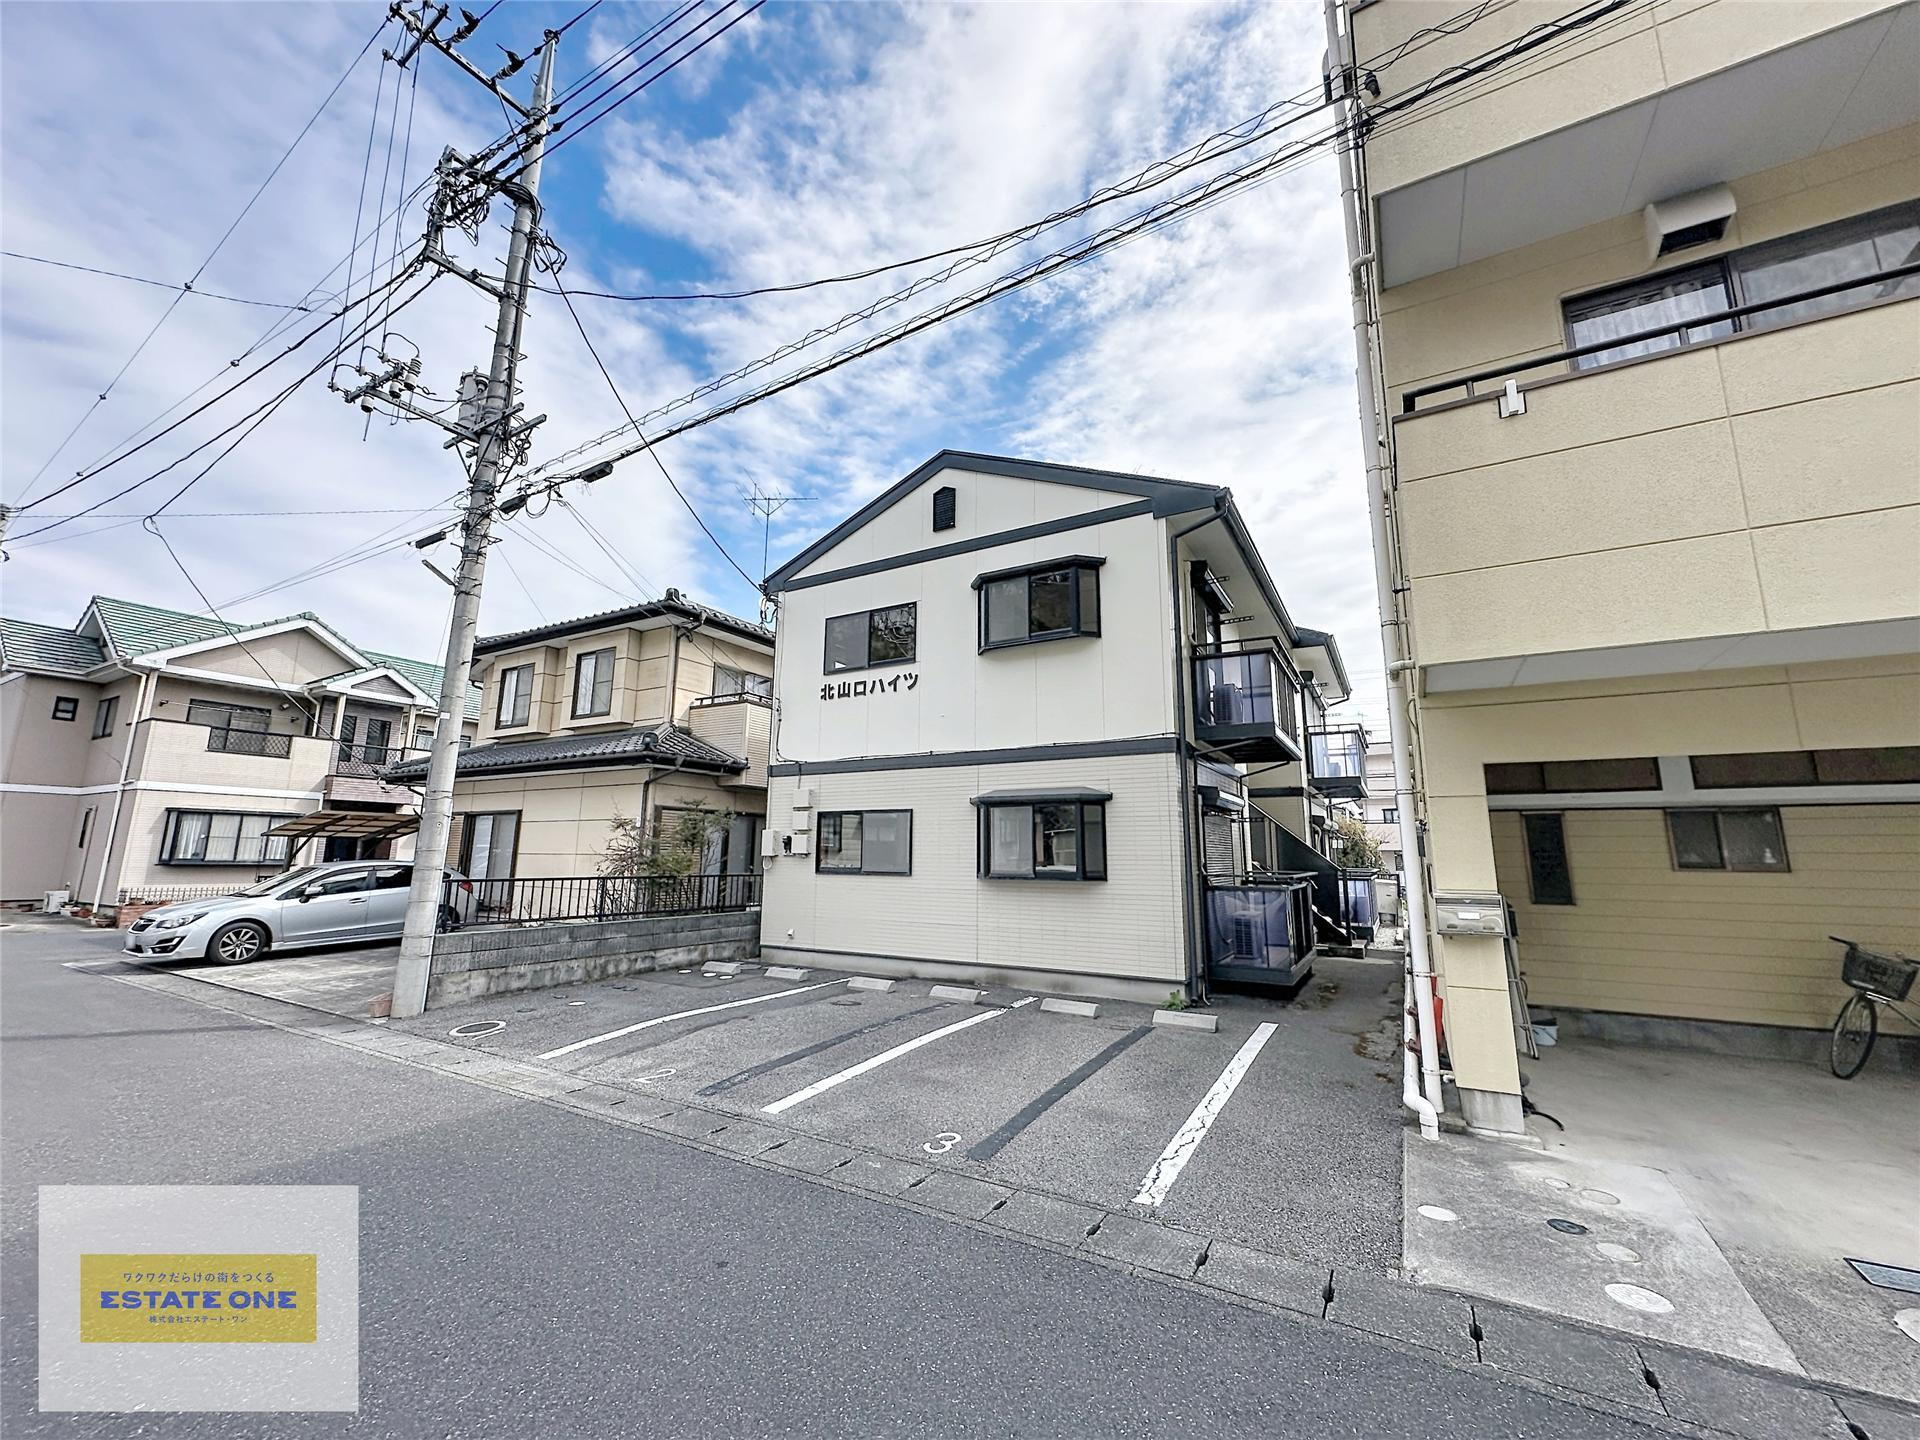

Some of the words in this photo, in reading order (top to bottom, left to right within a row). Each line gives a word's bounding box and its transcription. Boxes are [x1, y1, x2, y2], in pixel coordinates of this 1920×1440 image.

[820, 672, 919, 701] 北山口ハイツ
[634, 1068, 677, 1084] 2
[922, 1132, 962, 1154] 3
